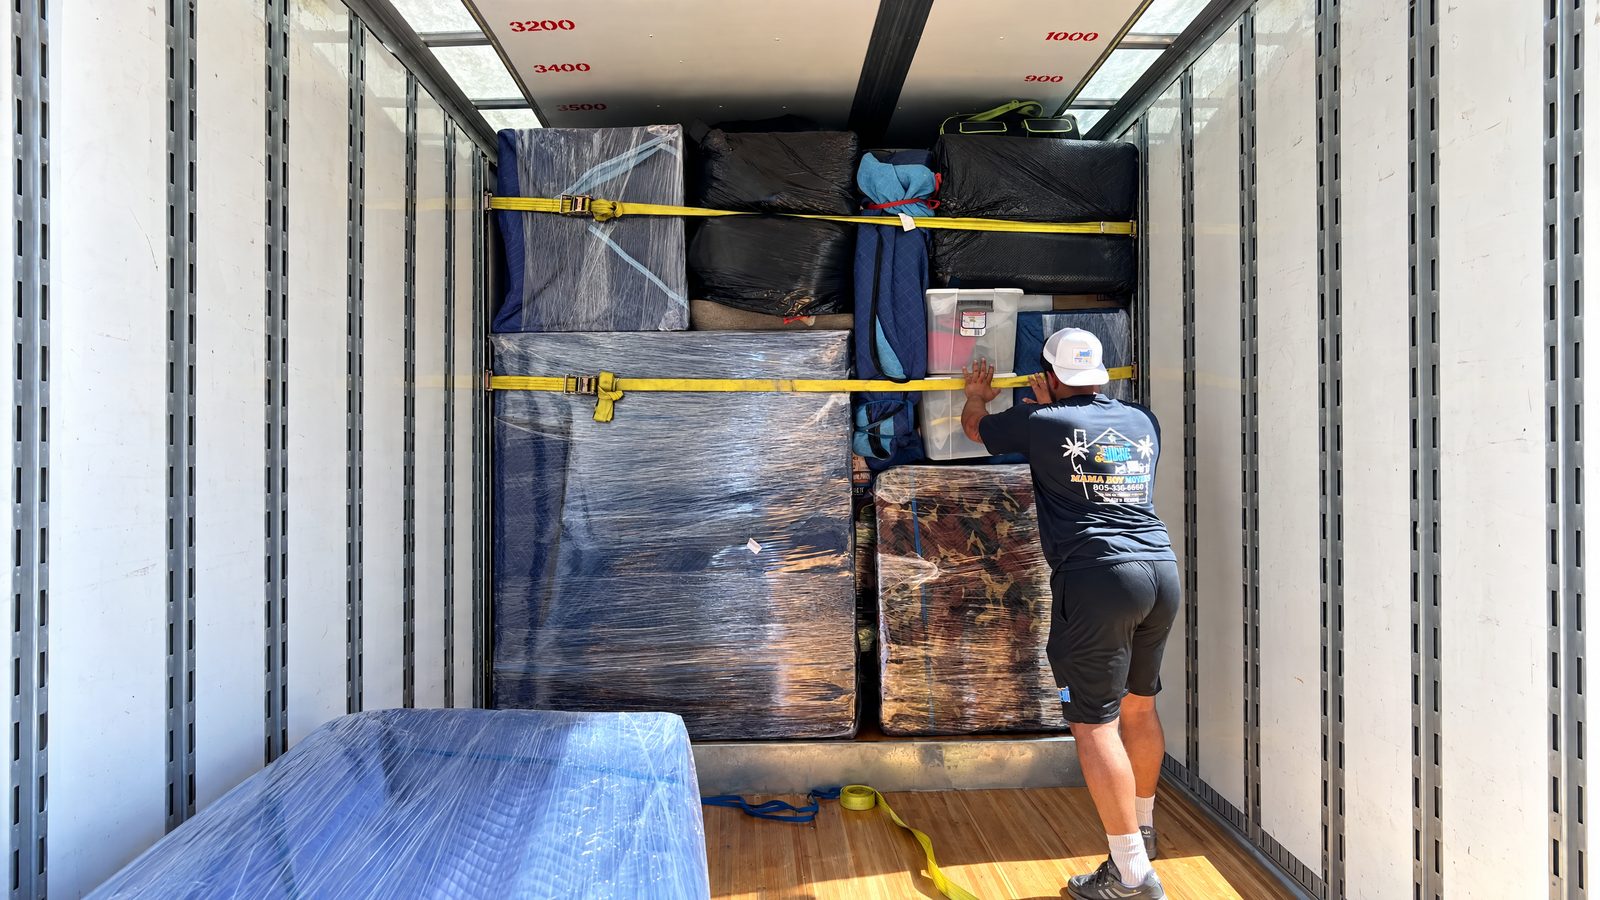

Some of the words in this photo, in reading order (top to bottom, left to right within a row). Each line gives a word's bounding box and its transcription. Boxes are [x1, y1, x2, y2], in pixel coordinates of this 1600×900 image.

[509, 19, 576, 32] 3200
[1045, 31, 1099, 42] 1000
[533, 63, 591, 73] 3400
[1024, 75, 1064, 83] 900
[556, 103, 607, 111] 3500
[1070, 474, 1105, 484] MAMA
[1105, 475, 1125, 485] BOY
